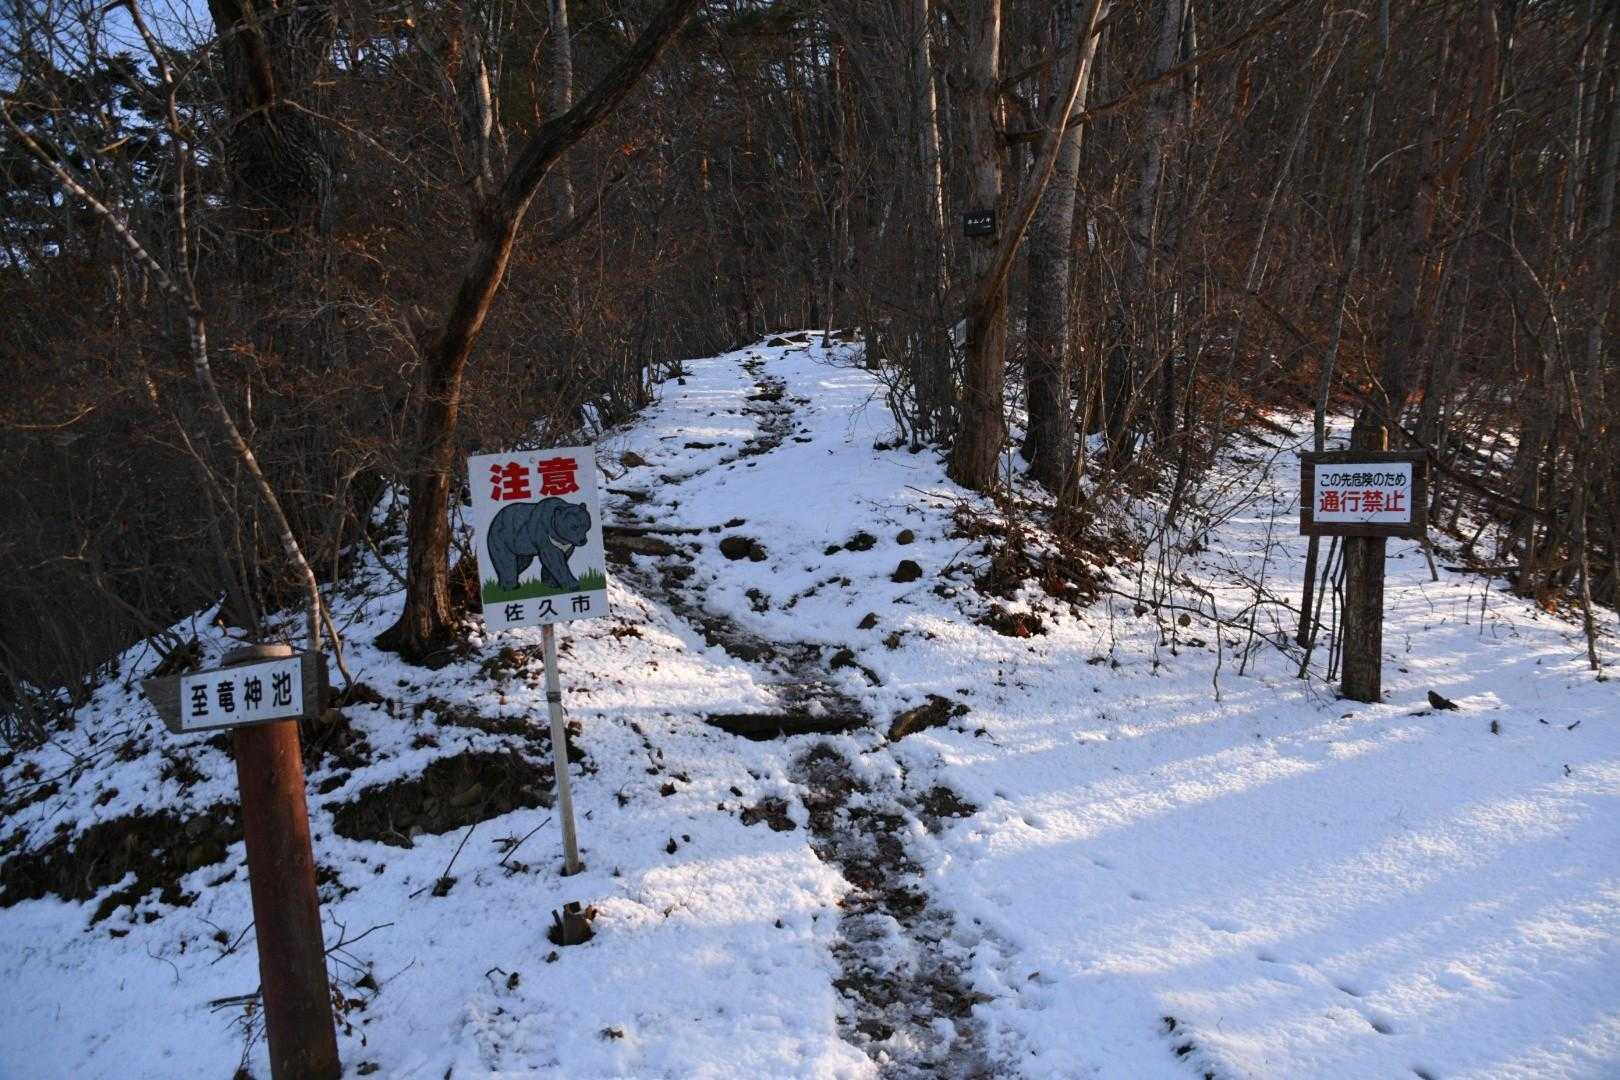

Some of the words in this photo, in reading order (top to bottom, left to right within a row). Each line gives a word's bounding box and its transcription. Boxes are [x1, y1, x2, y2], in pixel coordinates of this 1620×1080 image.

[489, 457, 580, 501] 注意
[1320, 473, 1406, 487] この先危険のため
[1319, 490, 1405, 512] 通行禁止
[504, 595, 591, 622] 佐久市
[190, 670, 292, 717] 至竜神池
